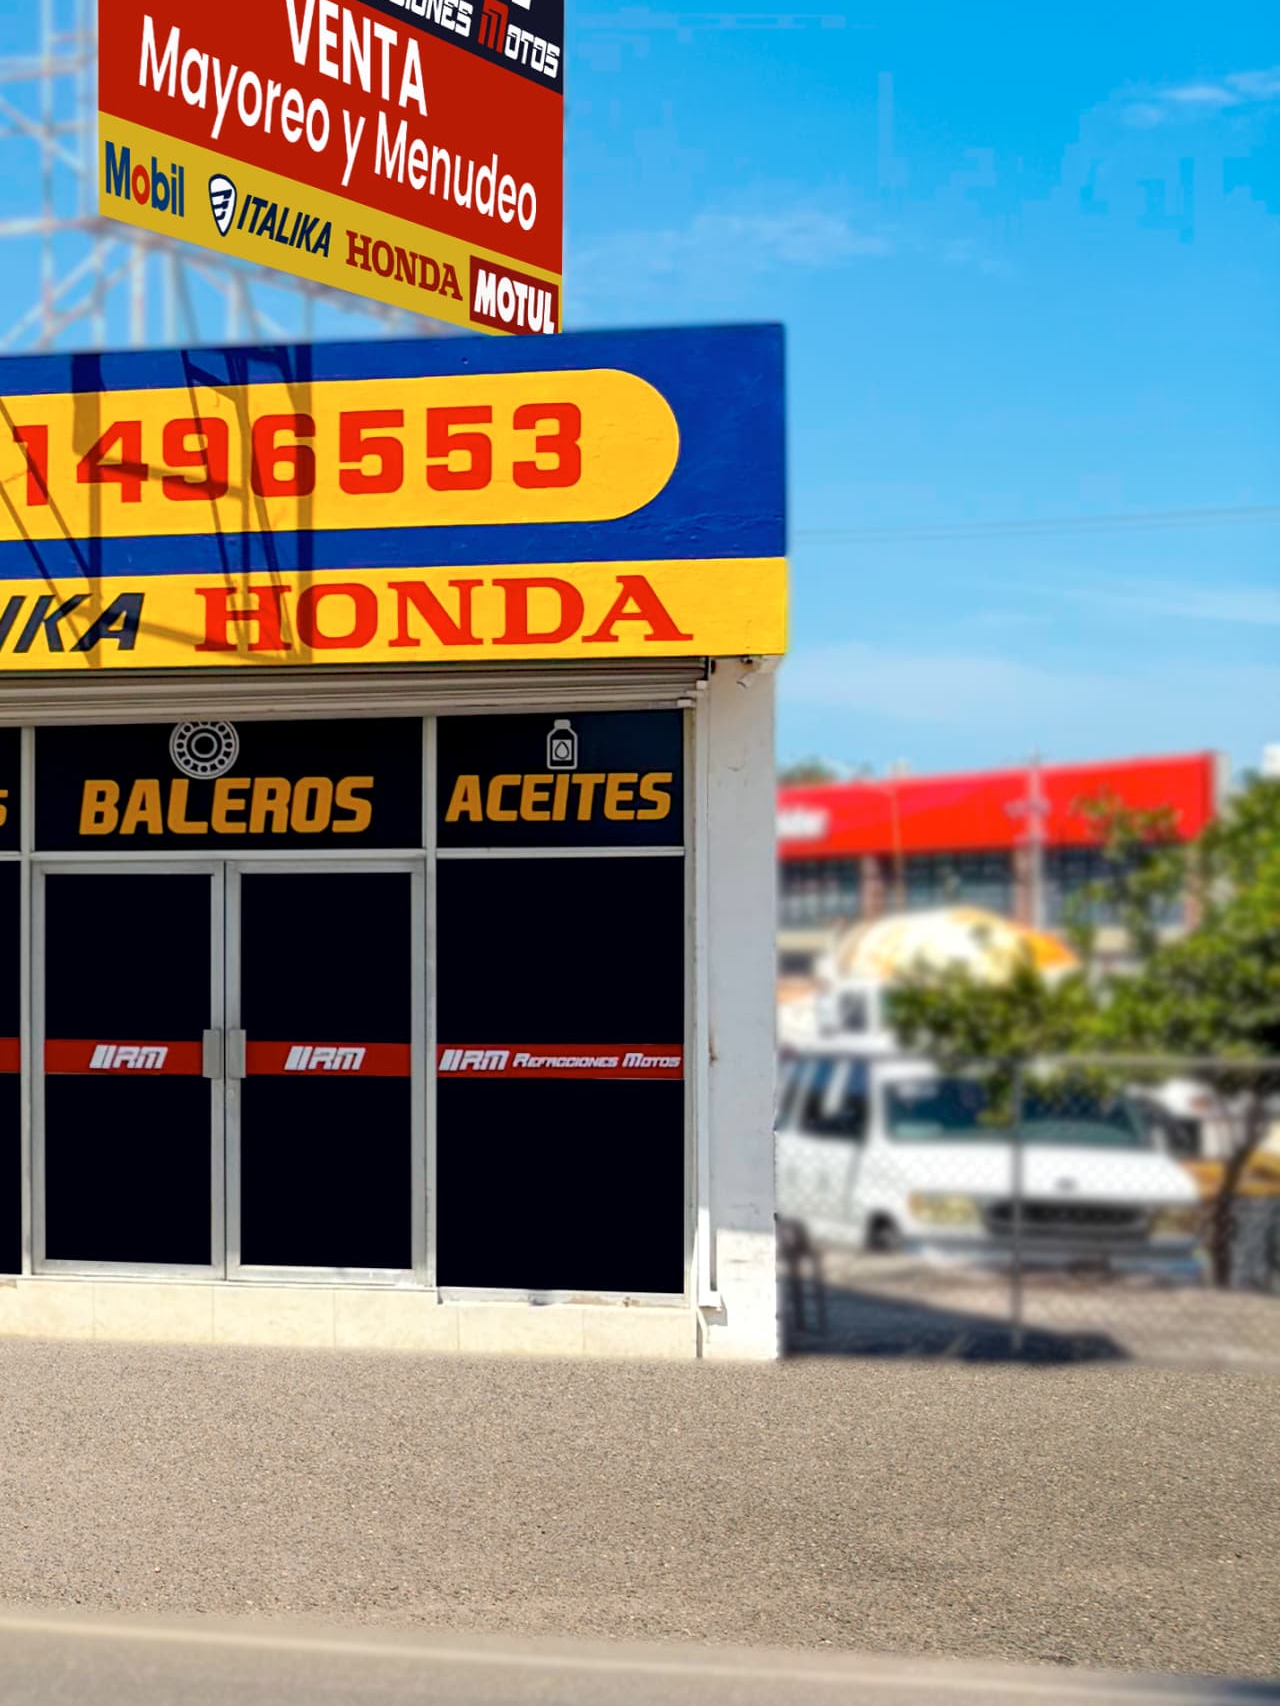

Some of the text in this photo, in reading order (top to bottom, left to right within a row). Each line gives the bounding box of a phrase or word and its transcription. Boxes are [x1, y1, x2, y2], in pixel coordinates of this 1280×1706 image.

[139, 15, 536, 231] Mayoreo y Menudeo
[105, 141, 185, 217] Mobil
[237, 194, 332, 257] ITALIKA
[346, 230, 463, 301] HONDA
[474, 269, 555, 334] MOTUL
[194, 575, 693, 652] HONDA
[78, 776, 374, 835] BALEROS
[445, 772, 673, 822] ACEITES
